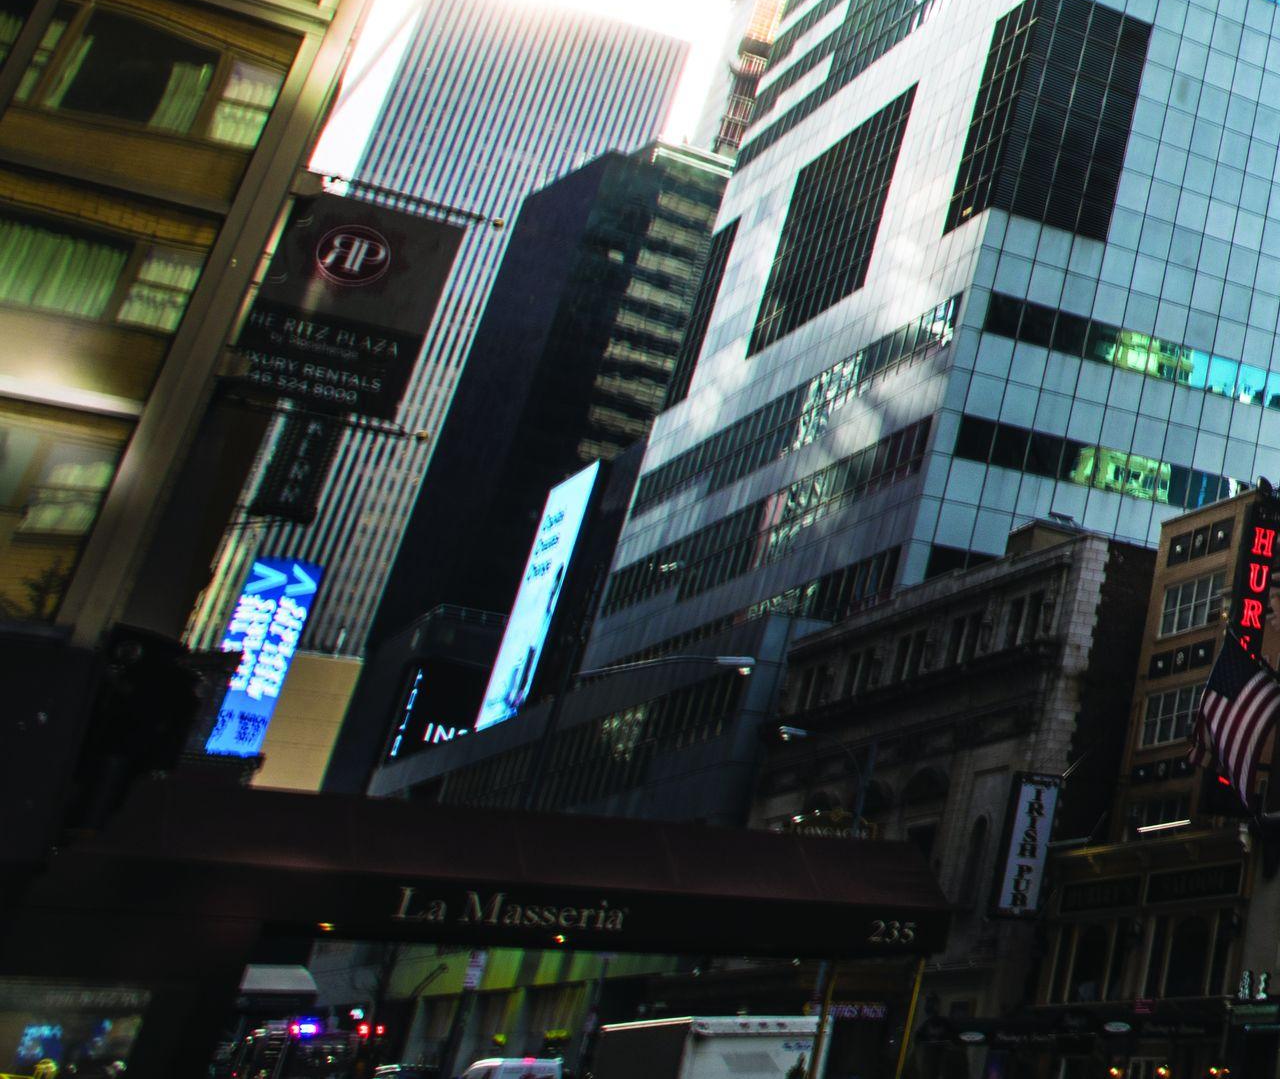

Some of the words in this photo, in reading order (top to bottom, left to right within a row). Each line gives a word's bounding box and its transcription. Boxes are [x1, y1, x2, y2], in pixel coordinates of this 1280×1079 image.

[284, 317, 331, 340] RITZ
[335, 328, 400, 359] PLAZA
[303, 362, 383, 392] RENTALS
[1019, 788, 1044, 858] IRISH
[1011, 864, 1033, 907] PUB
[391, 885, 448, 921] La
[456, 888, 626, 932] Masseria
[866, 919, 918, 945] 235
